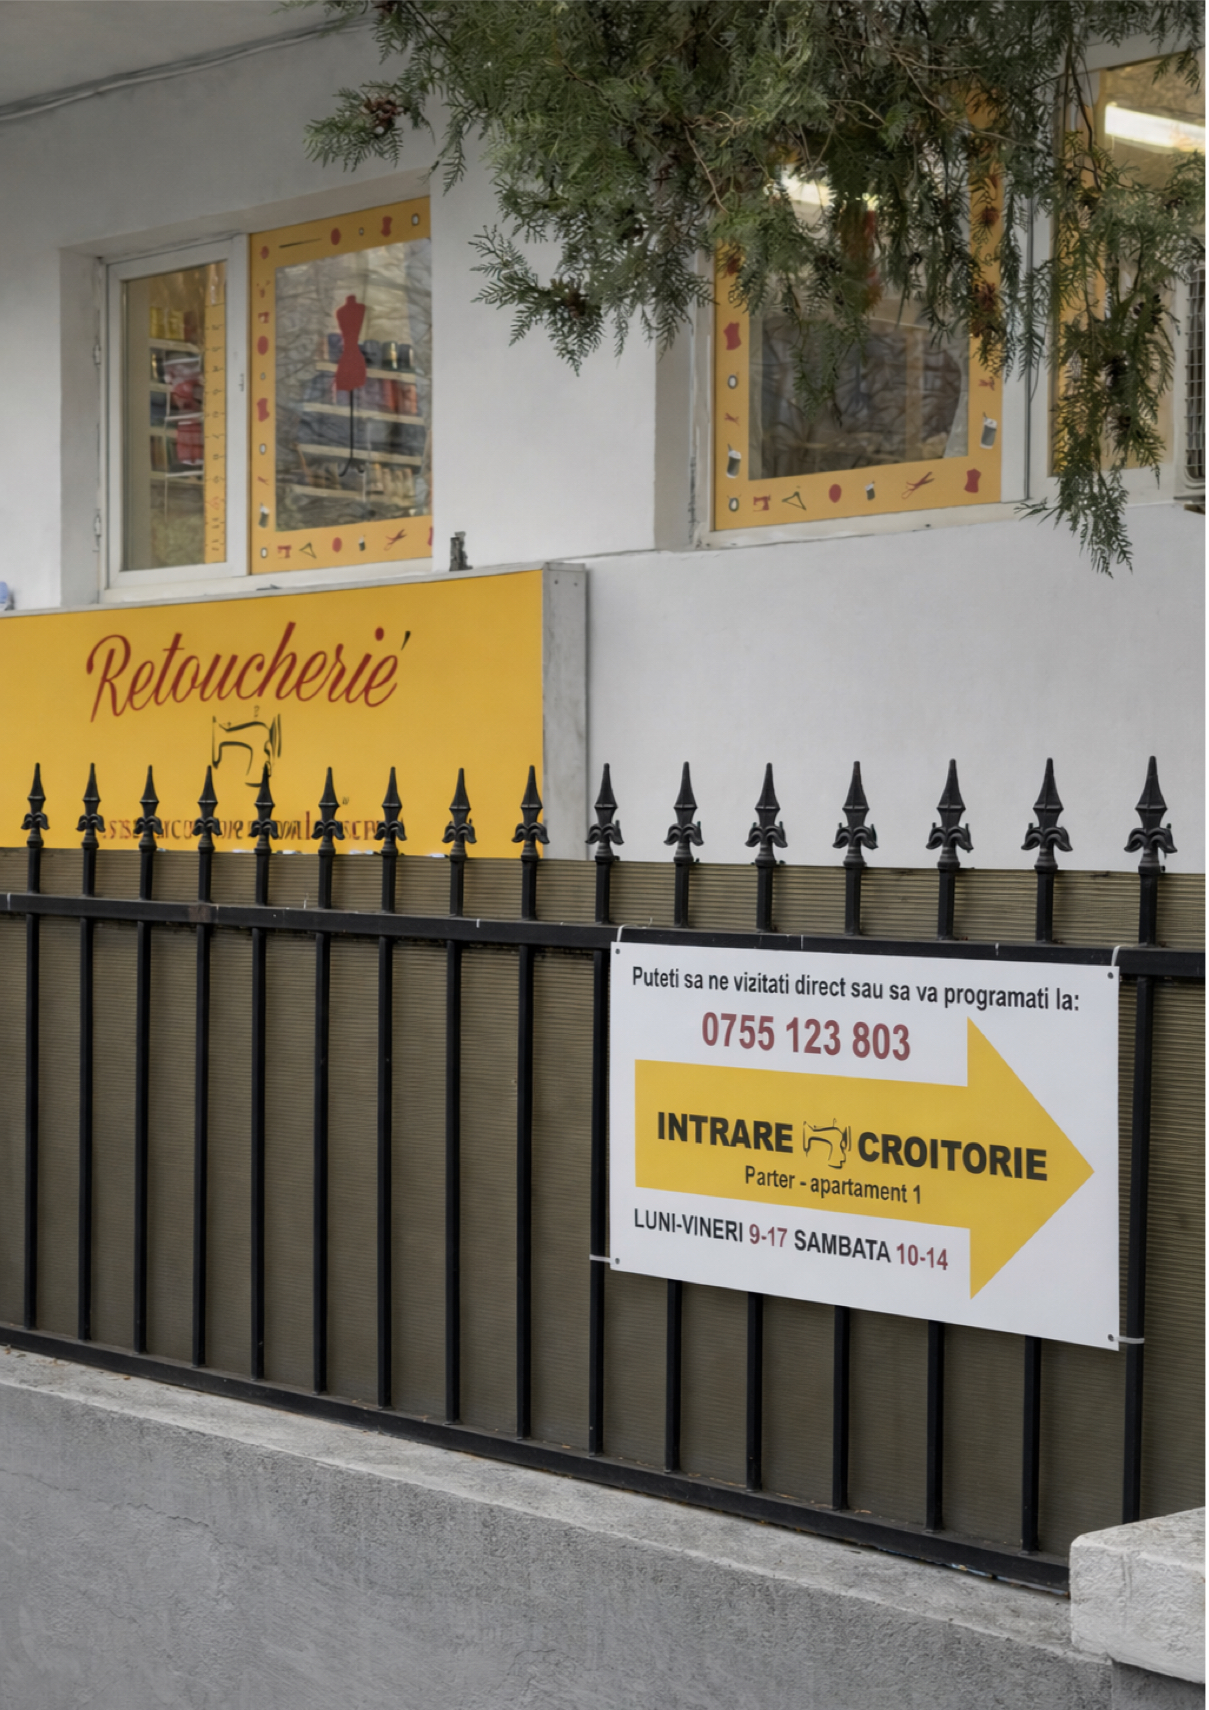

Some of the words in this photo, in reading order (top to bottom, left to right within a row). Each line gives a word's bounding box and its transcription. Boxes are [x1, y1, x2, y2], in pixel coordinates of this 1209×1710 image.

[632, 965, 680, 988] Puteti
[683, 973, 704, 990] sa
[708, 974, 729, 991] ne
[733, 972, 790, 995] vizitati
[794, 973, 847, 998] direct
[850, 981, 884, 1000] sau
[888, 984, 911, 1002] sa
[915, 985, 938, 1003] va
[944, 986, 1049, 1012] programati
[1056, 987, 1080, 1012] la:
[701, 1011, 775, 1052] 0755
[785, 1016, 841, 1056] 123
[852, 1021, 911, 1062] 803
[657, 1111, 794, 1154] INTRARE
[857, 1131, 1048, 1182] CROITORIE
[745, 1165, 796, 1190] Parter
[810, 1177, 908, 1204] apartament
[912, 1184, 921, 1206] 1
[634, 1207, 744, 1244] LUNI-VINERI
[748, 1223, 788, 1249] 9-17
[794, 1228, 892, 1264] SAMBATA
[896, 1242, 949, 1272] 10-14
